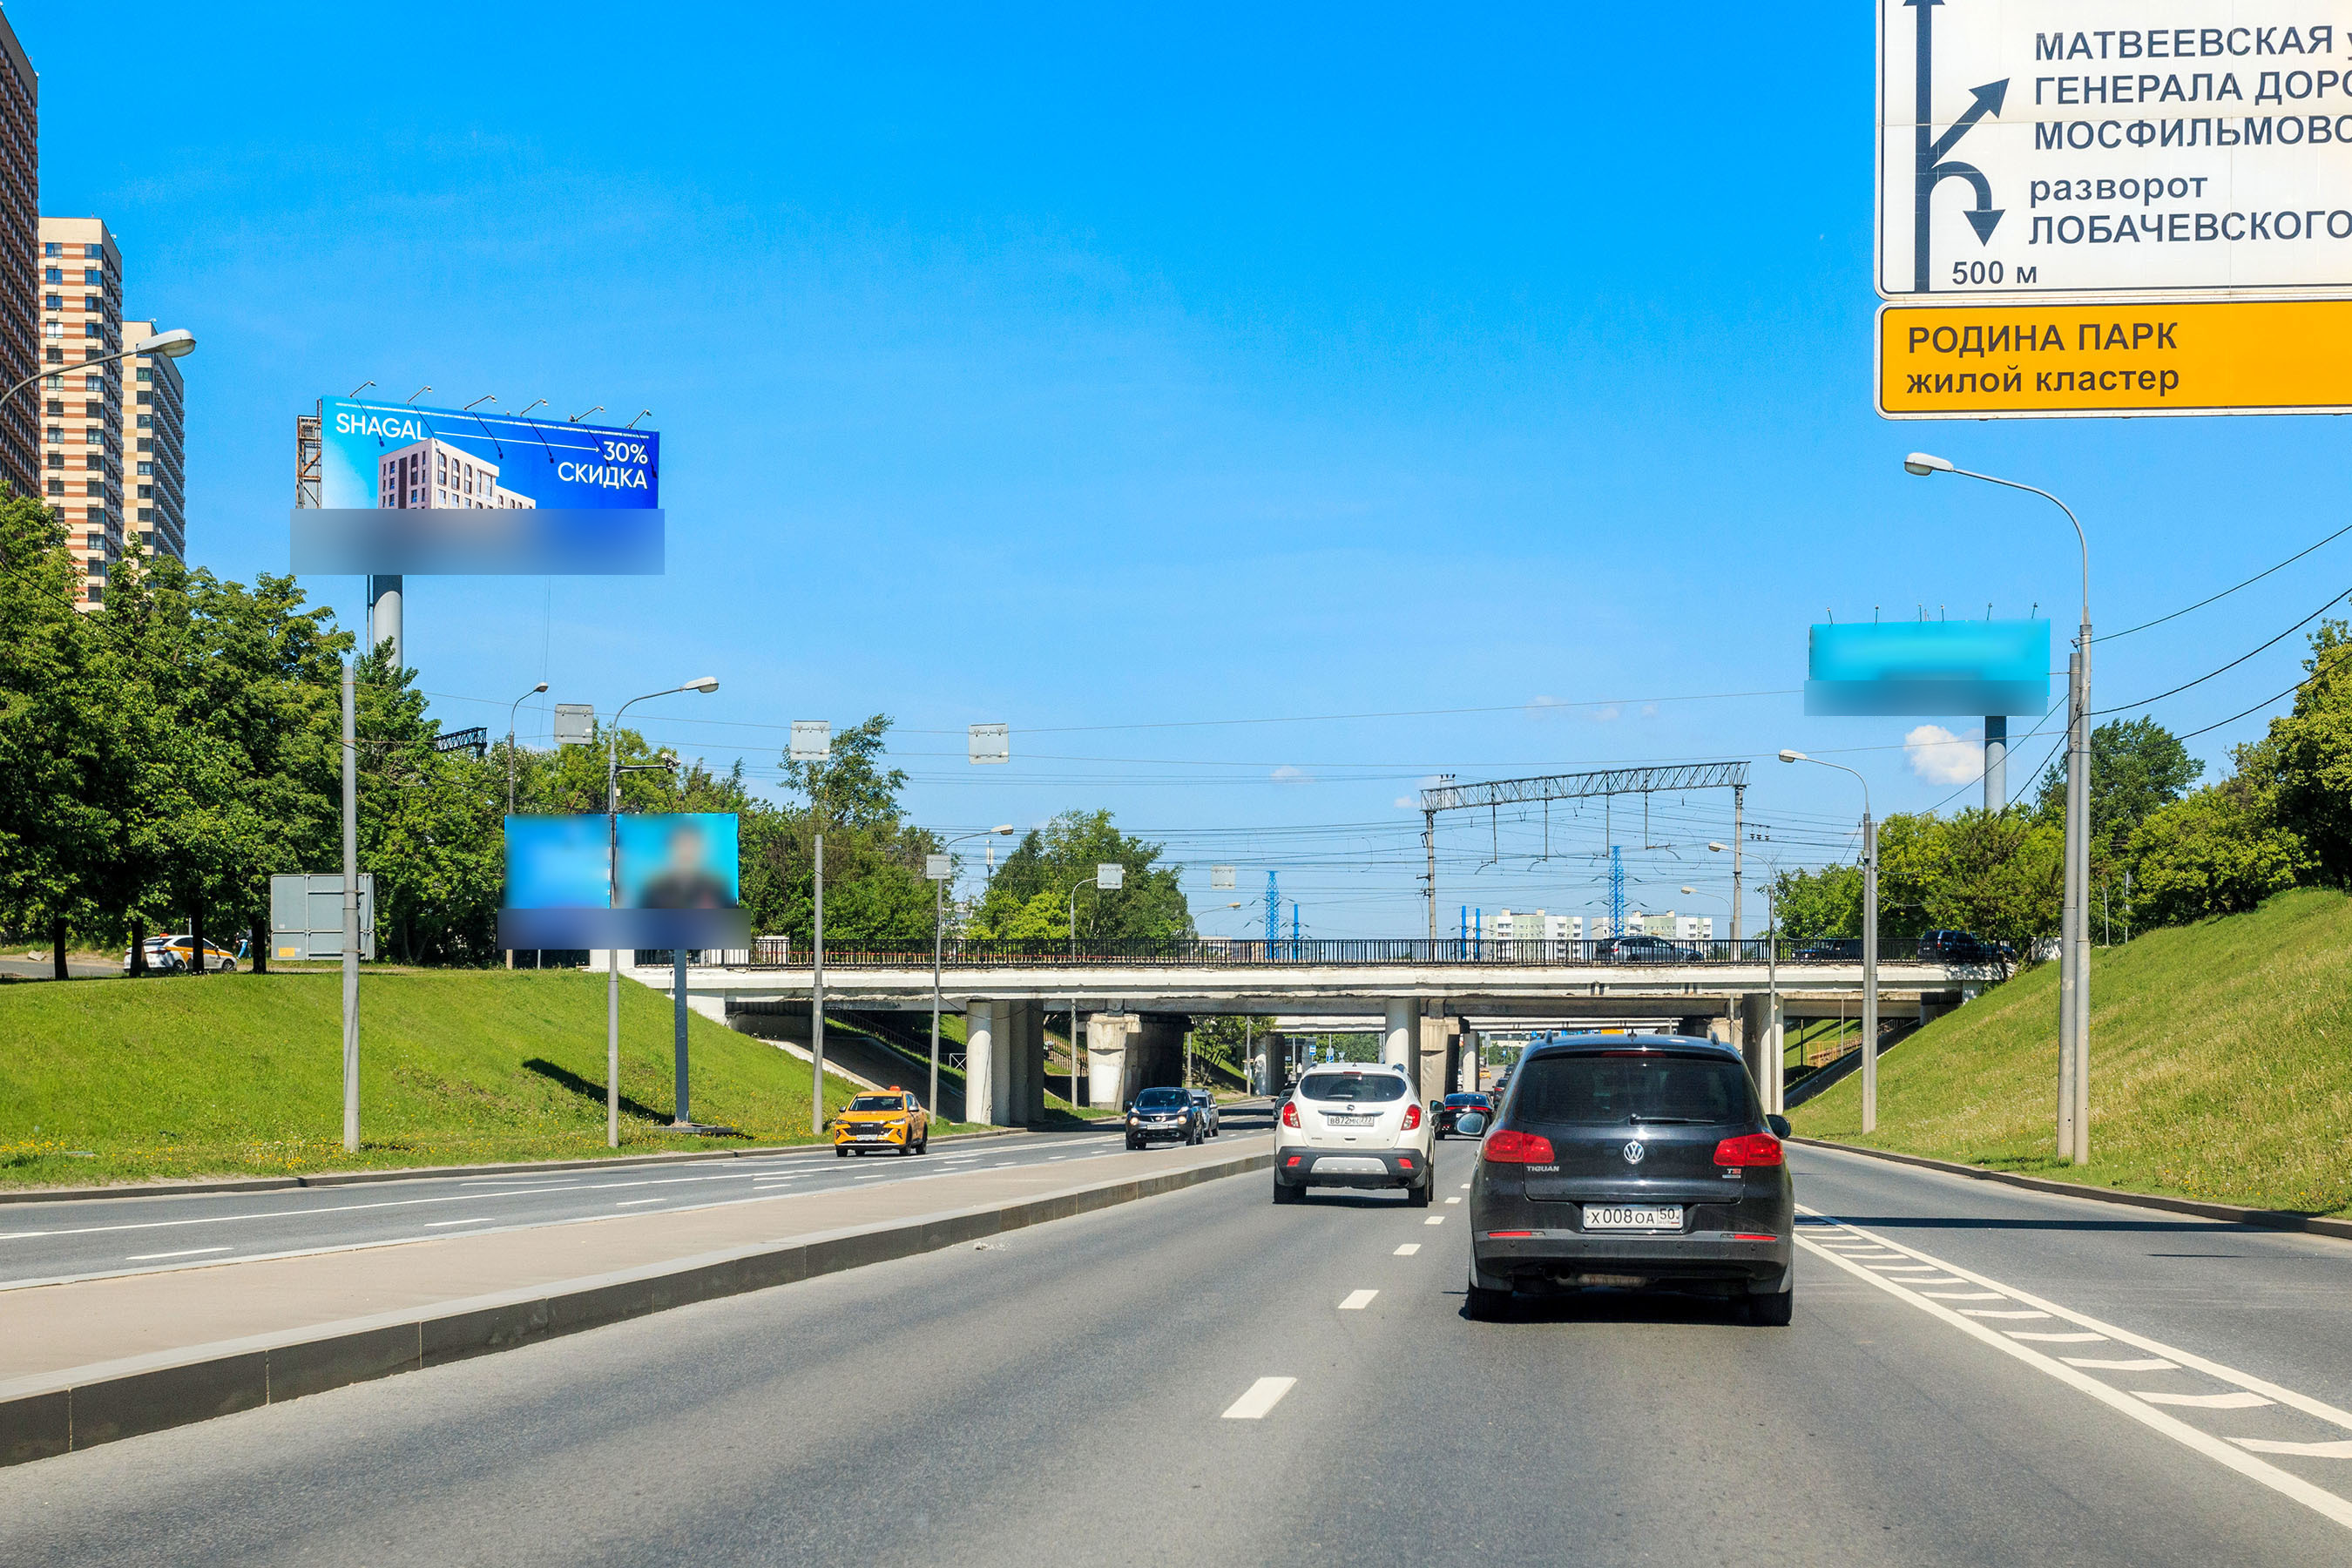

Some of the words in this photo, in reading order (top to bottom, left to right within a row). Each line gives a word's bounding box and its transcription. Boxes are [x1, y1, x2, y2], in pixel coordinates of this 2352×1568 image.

[2037, 25, 2332, 60] МАТВЕЕВСКАЯ
[2036, 73, 2243, 105] ГЕНЕРАЛА
[2031, 178, 2207, 208] разворот
[2029, 210, 2352, 244] ЛОБАЧЕВСКОГО
[1952, 261, 2004, 285] 500
[2017, 266, 2037, 284] м
[1909, 325, 2065, 358] РОДИНА
[2079, 322, 2177, 350] ПАРК
[1907, 365, 2021, 393] жилой
[2037, 370, 2179, 396] кластер
[335, 412, 429, 441] SHAGAL
[603, 441, 648, 464] 30%
[558, 461, 648, 490] СКИДКА
[1659, 1208, 1675, 1220] 50
